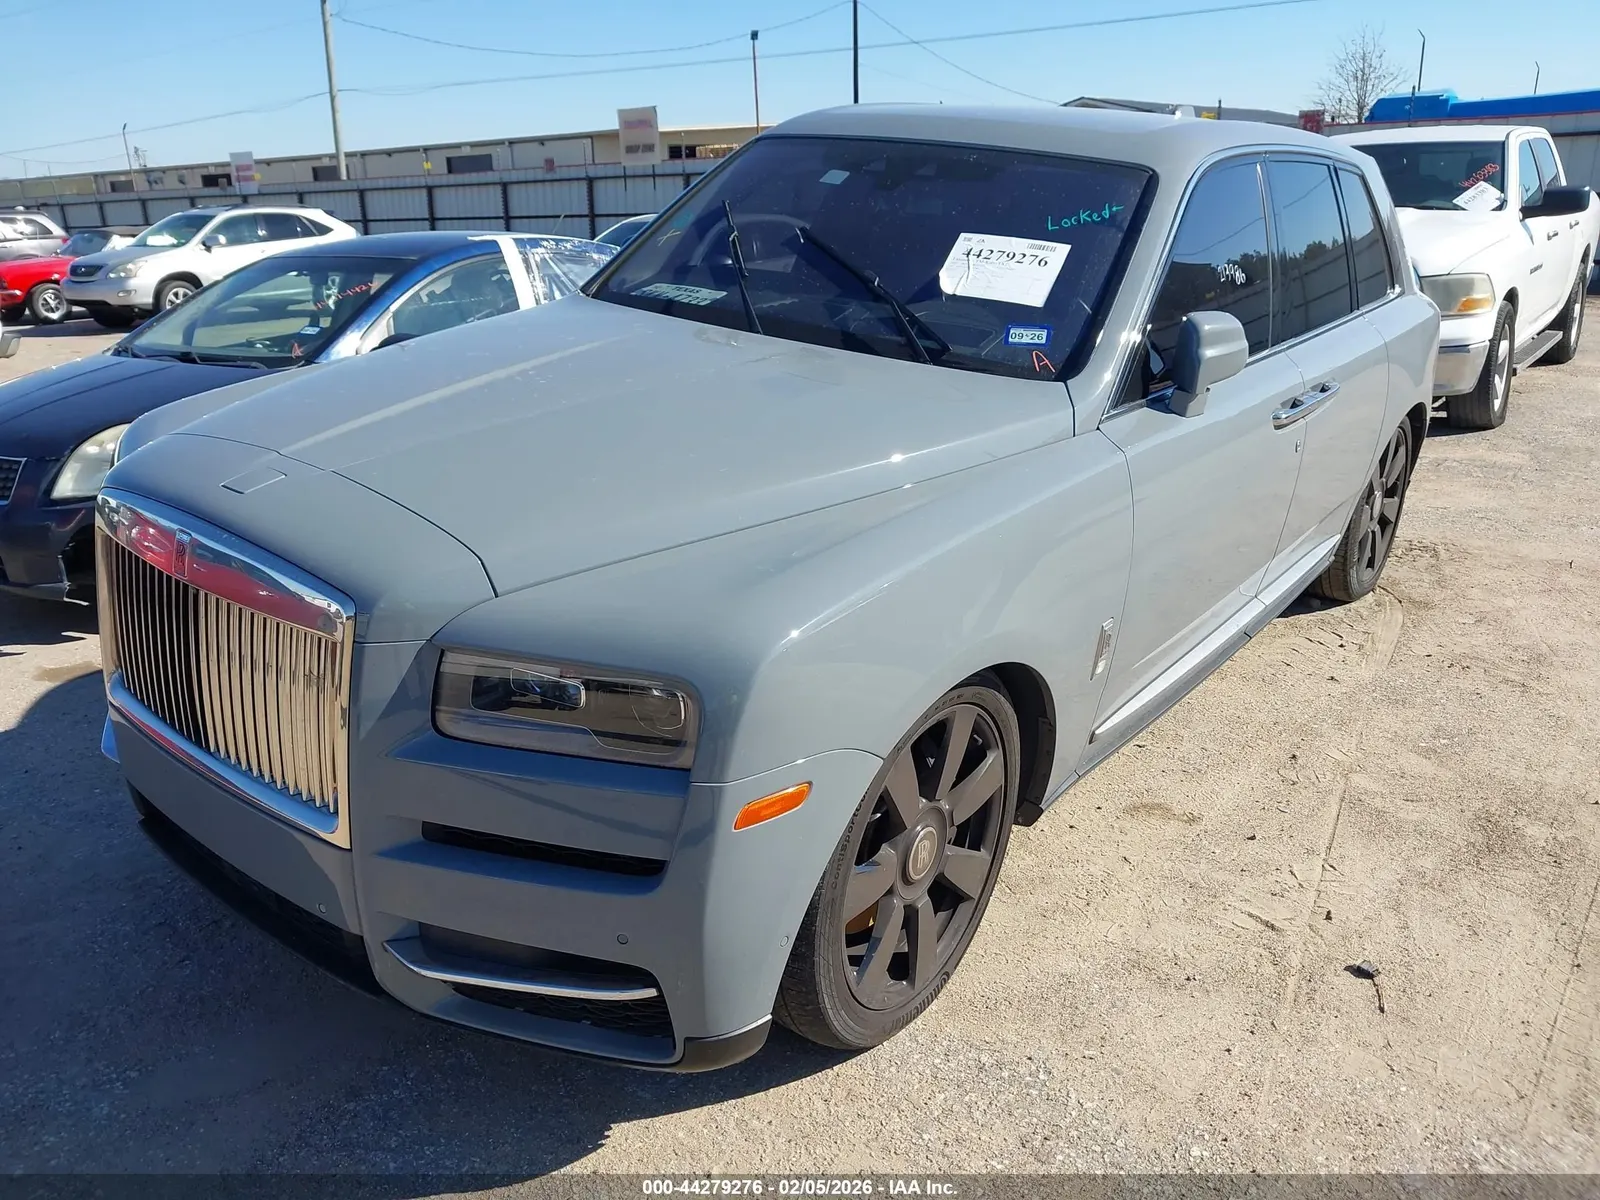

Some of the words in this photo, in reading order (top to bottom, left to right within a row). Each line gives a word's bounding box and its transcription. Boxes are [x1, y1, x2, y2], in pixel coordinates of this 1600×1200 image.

[962, 247, 1049, 268] 44279276
[671, 286, 702, 294] TEXAS
[1010, 332, 1024, 340] 09
[1030, 333, 1044, 341] 26
[1032, 350, 1056, 373] A
